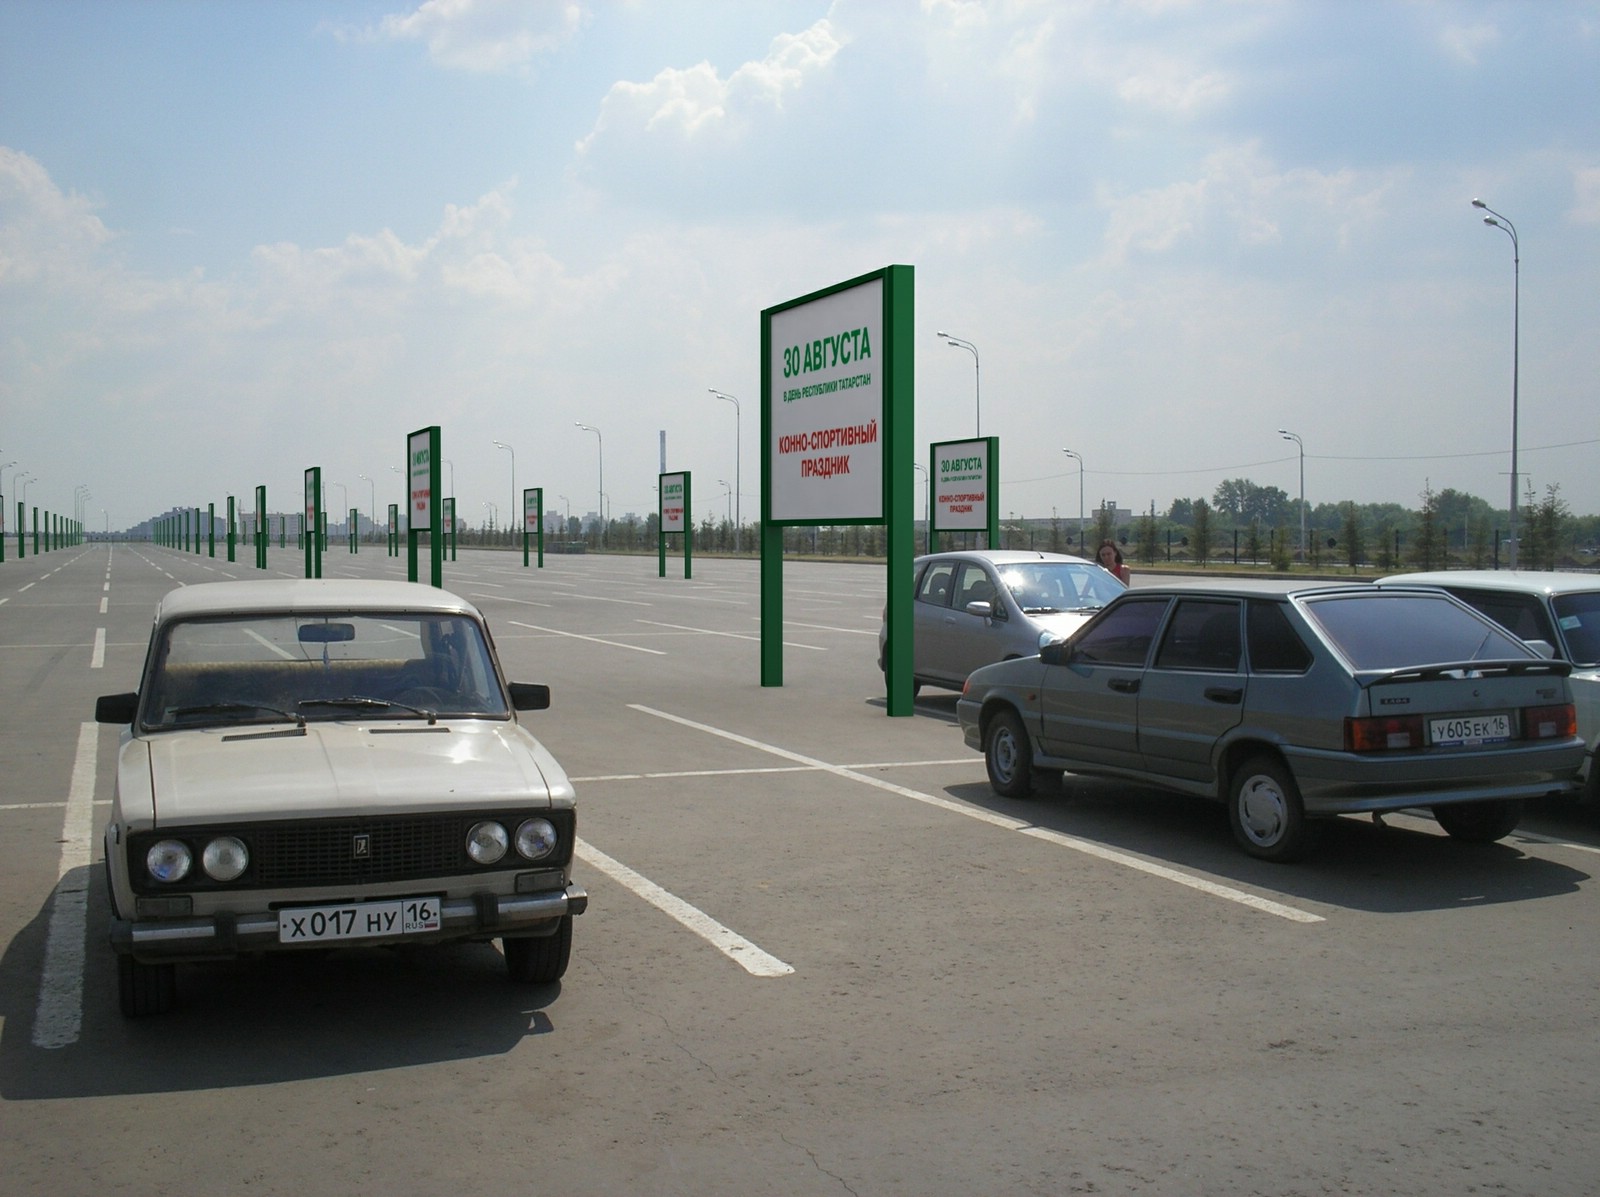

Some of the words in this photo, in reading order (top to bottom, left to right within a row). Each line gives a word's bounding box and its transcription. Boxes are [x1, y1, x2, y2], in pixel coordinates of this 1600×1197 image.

[783, 345, 800, 378] 30
[803, 327, 871, 373] АВГУСТА
[783, 391, 787, 402] В
[788, 388, 801, 403] ДЕНЬ
[802, 381, 838, 398] РЕСПУБЛИКИ
[839, 373, 871, 391] ТАТАРСТАН
[779, 419, 877, 454] КОННО-СПОРТИВНЫЙ
[801, 455, 850, 479] ПРАЗДНИК
[941, 459, 950, 473] 30
[951, 457, 982, 472] АВГУСТА
[1493, 718, 1505, 730] 16
[407, 902, 431, 922] 16
[405, 921, 424, 930] RUS
